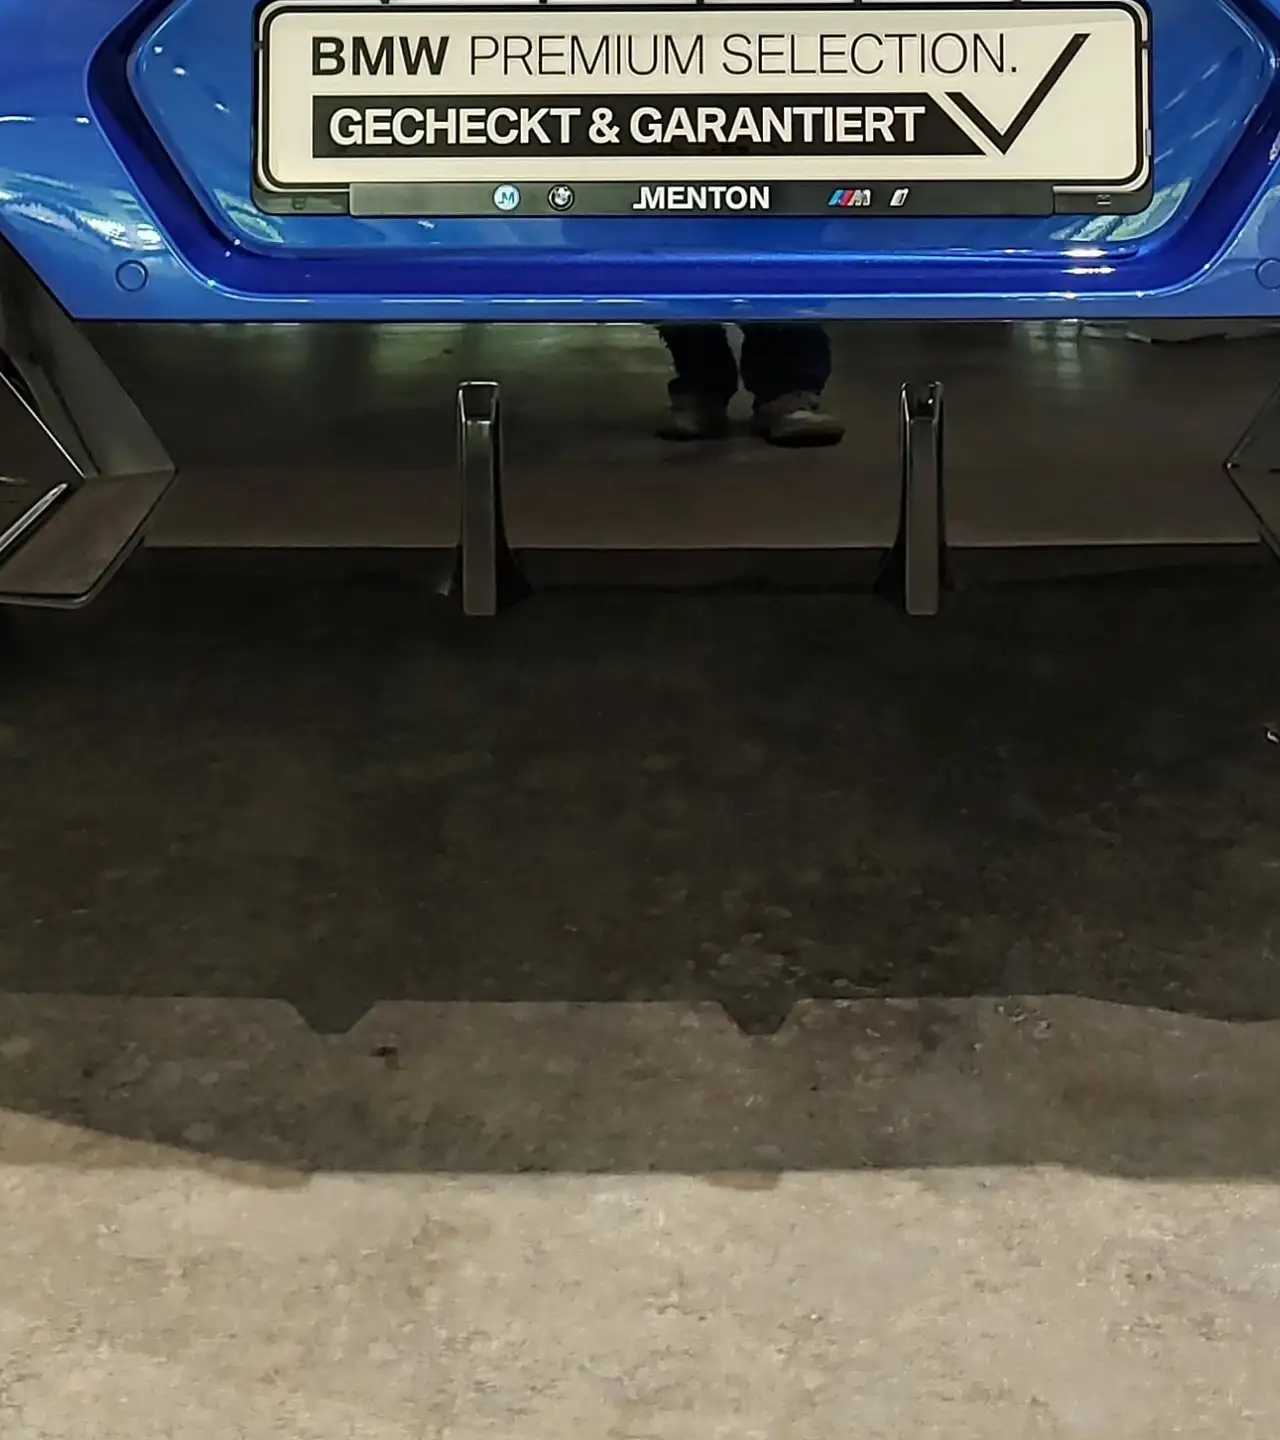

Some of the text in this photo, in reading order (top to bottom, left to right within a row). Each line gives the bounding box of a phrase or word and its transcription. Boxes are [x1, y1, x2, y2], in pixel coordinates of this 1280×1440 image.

[311, 32, 1018, 76] BMW PREMIUM SELECTION.
[329, 105, 926, 146] GECHECKT & GARANTIERT
[632, 185, 771, 210] MENTON
